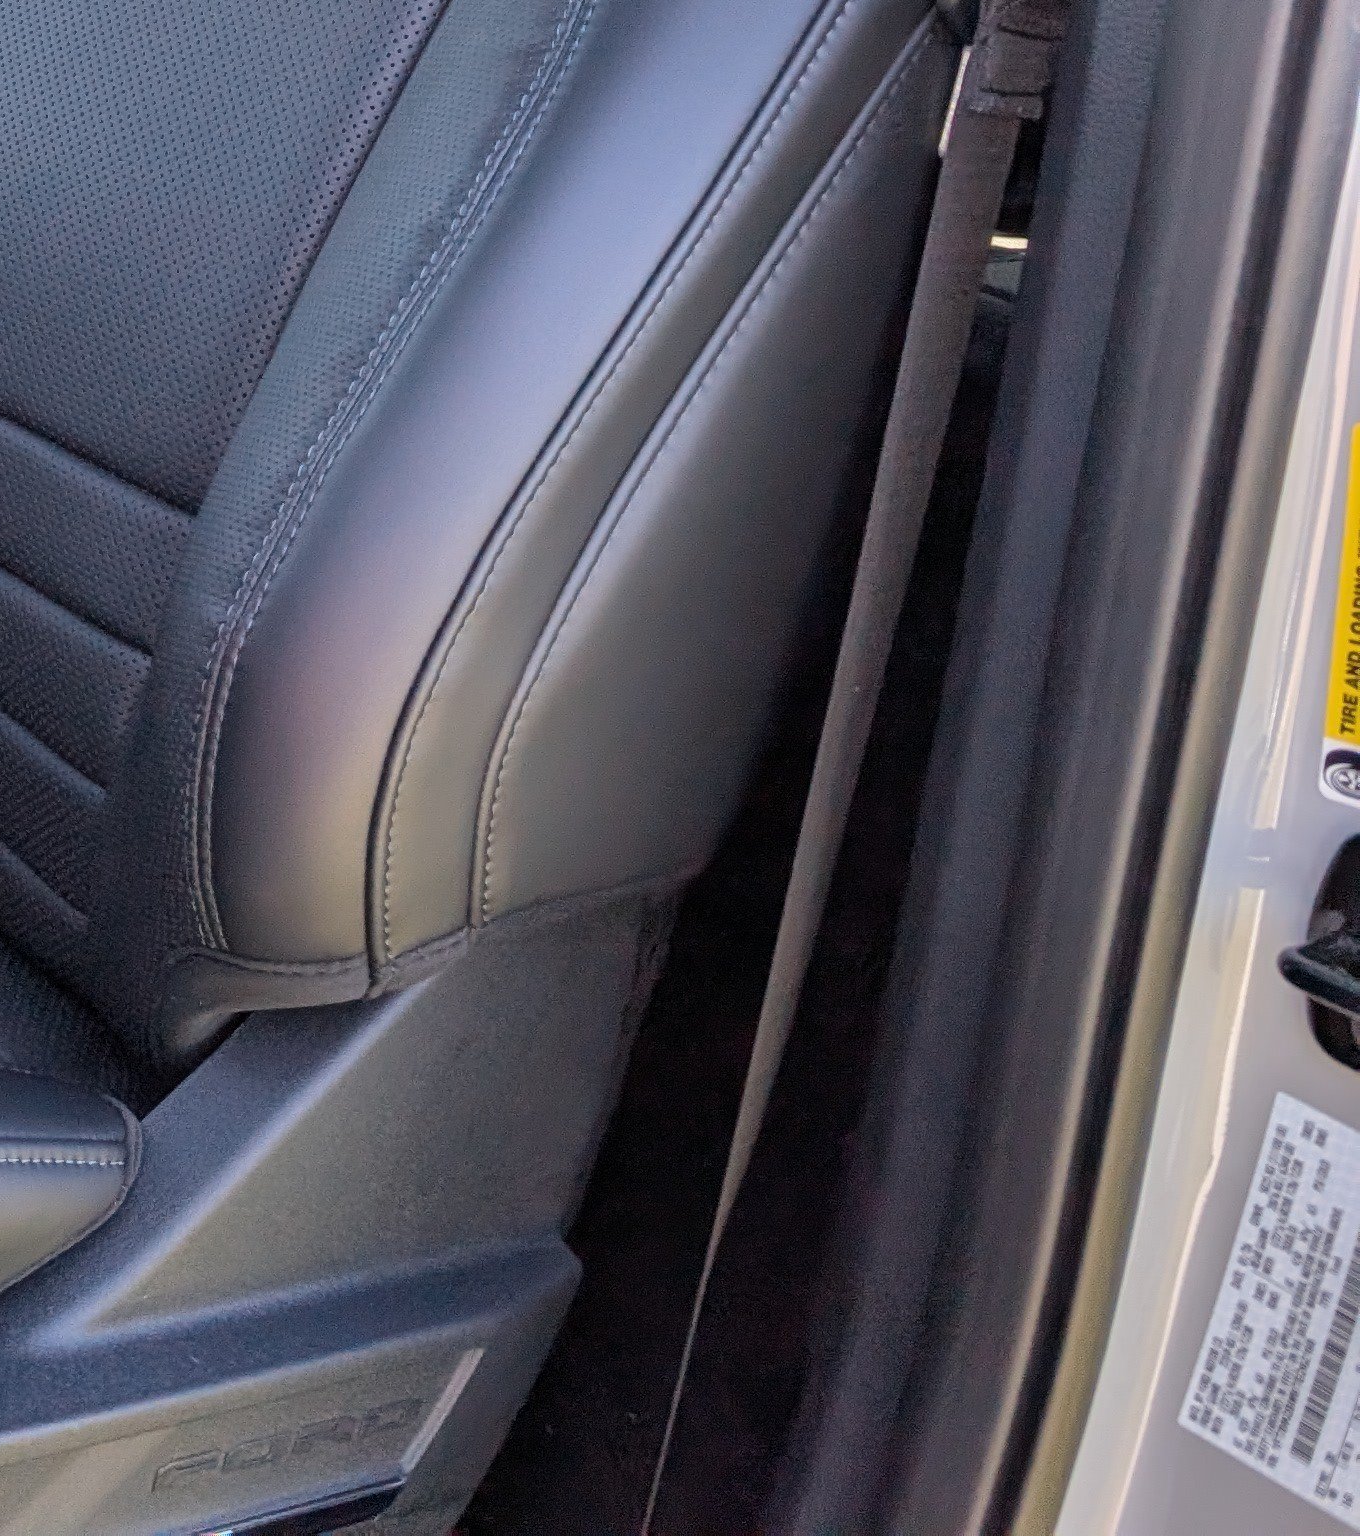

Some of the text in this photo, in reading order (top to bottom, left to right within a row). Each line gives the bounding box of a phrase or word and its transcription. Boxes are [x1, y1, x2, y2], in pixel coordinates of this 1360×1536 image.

[1344, 650, 1360, 690] AND
[1339, 693, 1359, 735] TIRE
[149, 1394, 428, 1495] FORD
